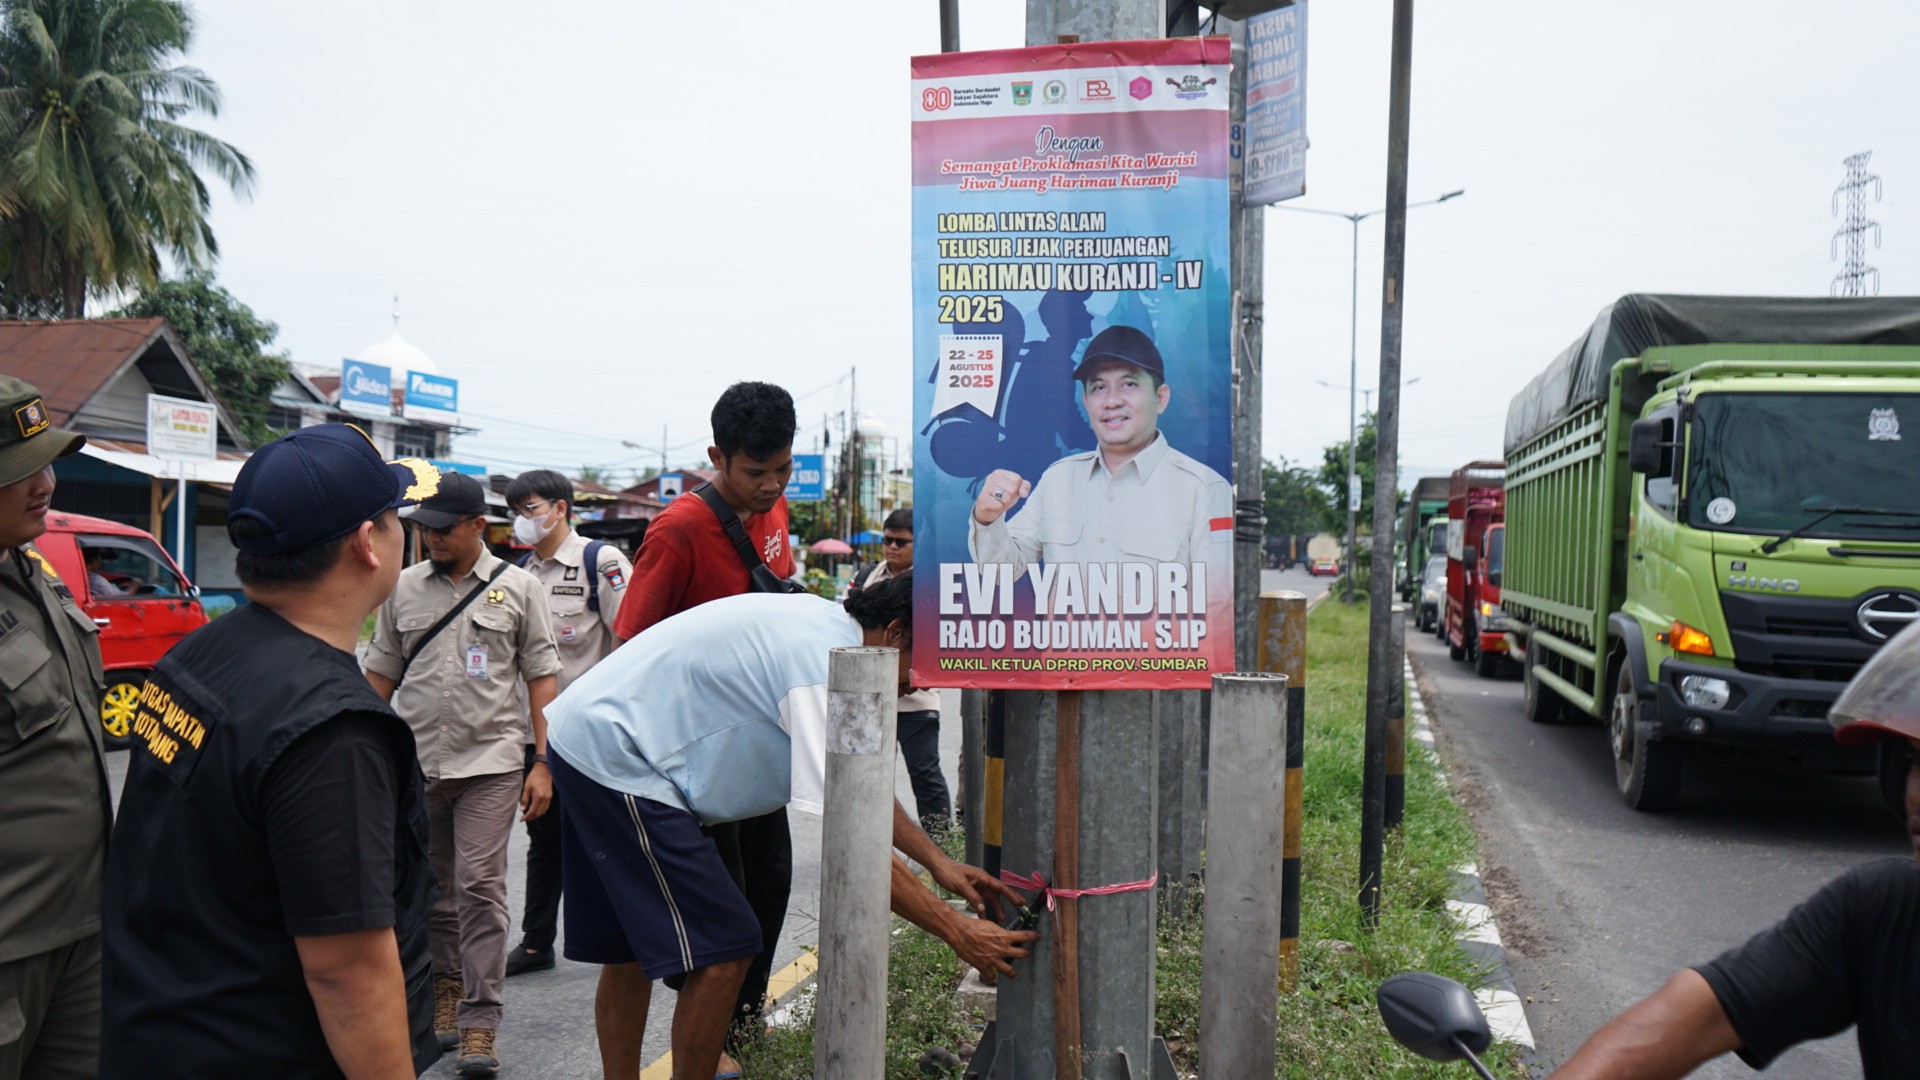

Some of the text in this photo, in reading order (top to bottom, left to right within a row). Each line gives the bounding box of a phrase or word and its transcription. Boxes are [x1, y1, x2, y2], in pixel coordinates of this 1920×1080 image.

[1036, 126, 1103, 163] Dengan
[942, 151, 1197, 175] Semangat Proklamasi Kita Warisi
[960, 171, 1178, 192] Jiwa Juang Harimau Kuranji
[939, 211, 1105, 232] LOMBA LINTAS ALAM
[938, 236, 1170, 258] TELUSUR JEJAK PERJUANGAN
[938, 263, 1052, 292] HARIMAU
[1056, 262, 1157, 292] KURANJI
[1175, 260, 1203, 290] IV
[938, 295, 1003, 324] 2025
[949, 350, 966, 360] 22
[977, 350, 994, 360] 25
[949, 363, 994, 371] AGUSTUS
[949, 375, 994, 388] 2025
[939, 562, 1207, 614] EVI YANDRI
[1728, 574, 1800, 592] HINO
[939, 619, 1207, 649] RAJO BUDIMAN. S.IP
[939, 657, 1208, 671] WAKIL KETUA DPRD PROV. SUMBAR
